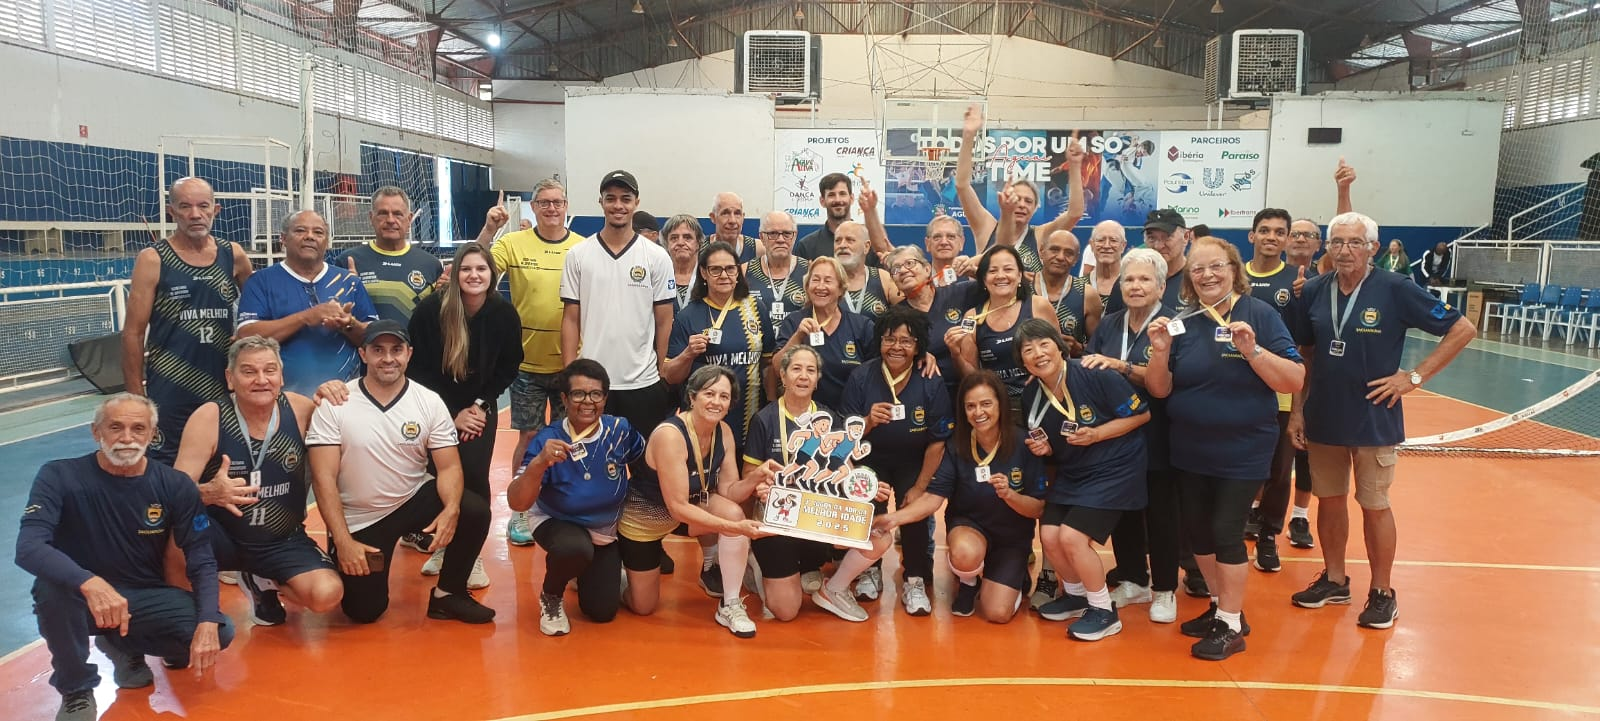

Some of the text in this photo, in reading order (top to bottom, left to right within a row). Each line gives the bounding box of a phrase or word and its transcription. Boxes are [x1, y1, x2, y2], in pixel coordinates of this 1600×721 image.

[1000, 136, 1047, 154] POR
[986, 161, 1051, 182] TIME
[180, 309, 198, 320] VIVA
[200, 308, 229, 319] MELHOR
[200, 327, 214, 343] 12
[256, 482, 291, 498] MELHOR
[249, 507, 266, 526] 11
[803, 505, 867, 525] MELHOR IDADE
